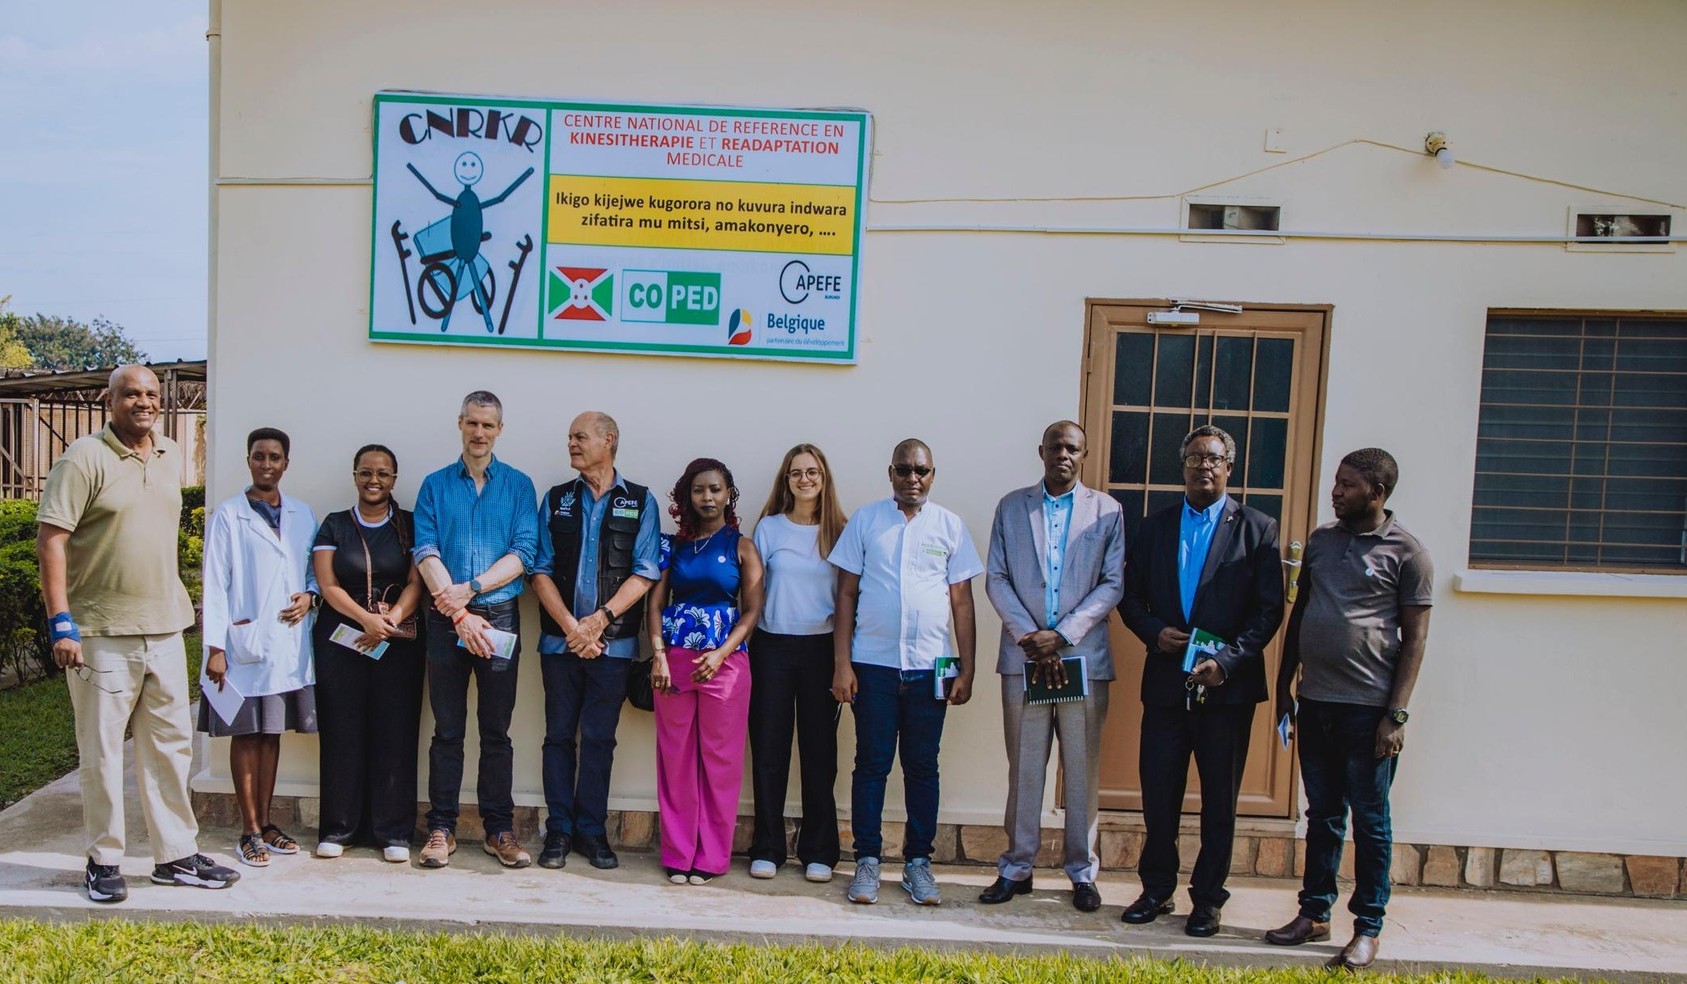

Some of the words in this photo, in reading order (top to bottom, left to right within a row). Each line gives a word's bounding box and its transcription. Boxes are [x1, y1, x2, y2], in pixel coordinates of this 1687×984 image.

[399, 107, 543, 153] CNRKR
[564, 114, 622, 129] CENTRE
[627, 116, 704, 133] NATIONAL
[709, 119, 728, 134] DE
[733, 120, 819, 137] REFERENCE
[824, 124, 844, 138] EN
[570, 131, 694, 149] KINESITHERAPIE
[699, 136, 716, 150] ET
[721, 137, 840, 155] READAPTATION
[667, 152, 743, 168] MEDICALE
[556, 192, 590, 209] Ikigo
[594, 193, 644, 210] kijejwe
[649, 195, 711, 212] kugorora
[716, 200, 734, 212] no
[738, 198, 786, 214] kuvura
[790, 201, 847, 216] indwara
[581, 213, 633, 228] zifatira
[639, 218, 662, 229] mu
[668, 216, 710, 232] mitsi,
[715, 219, 814, 238] amakonyero,
[767, 313, 825, 334] Belgique
